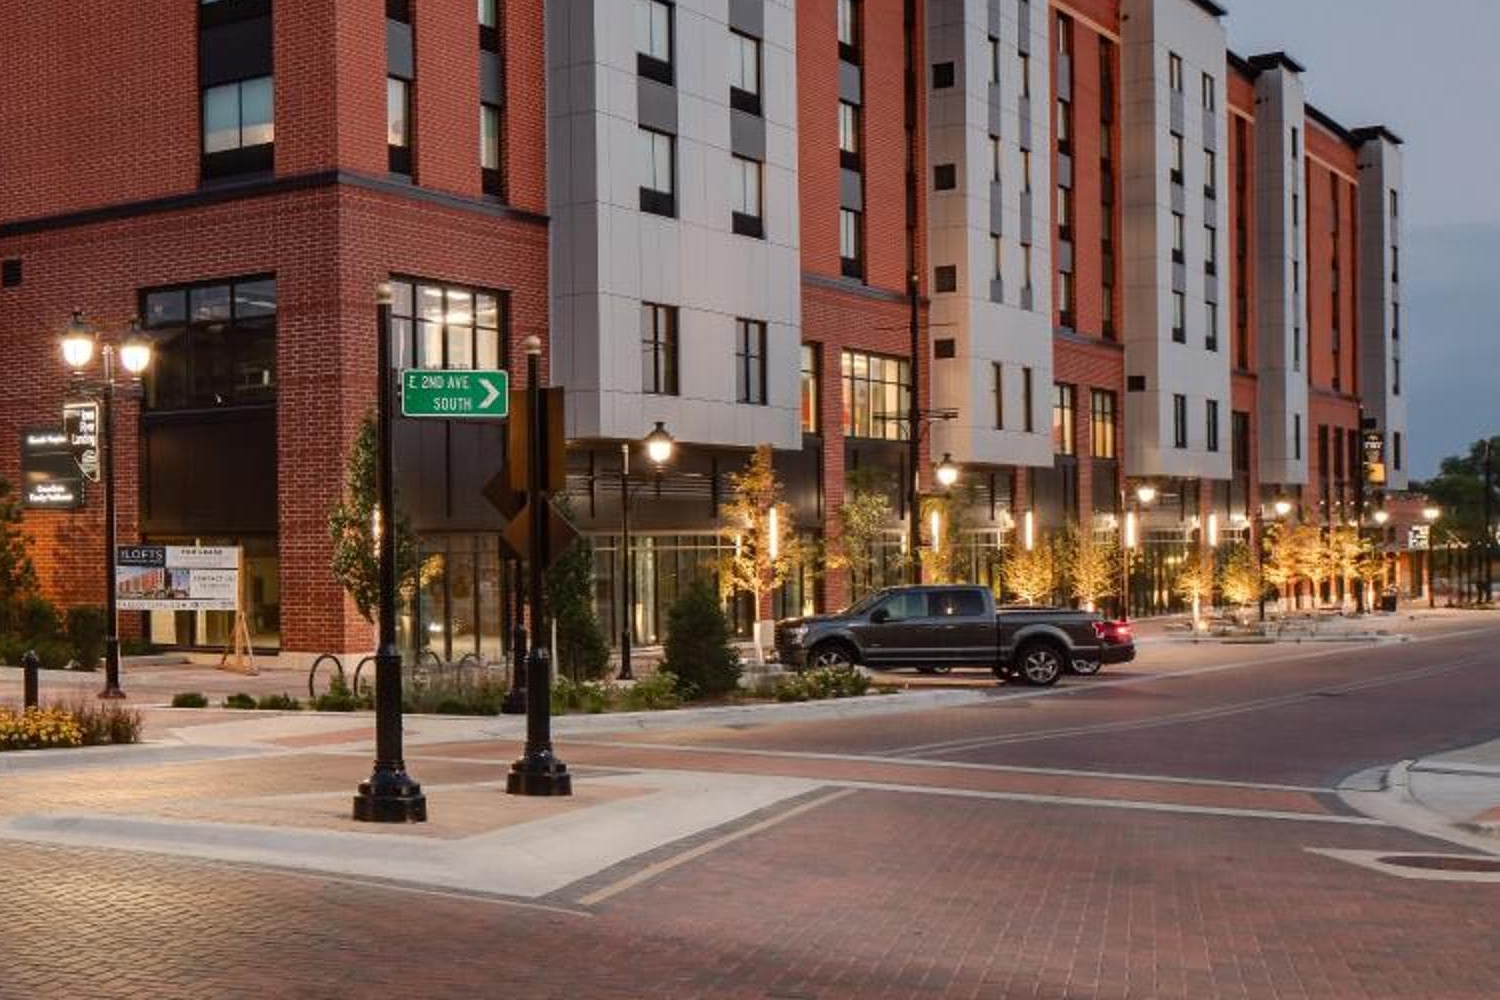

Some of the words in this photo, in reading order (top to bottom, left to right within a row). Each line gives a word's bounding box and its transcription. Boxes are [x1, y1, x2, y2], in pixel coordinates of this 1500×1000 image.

[408, 375, 417, 389] E
[421, 375, 444, 389] 2ND
[447, 375, 471, 389] AVE
[433, 397, 473, 411] SOUTH
[125, 549, 163, 560] LOFTS
